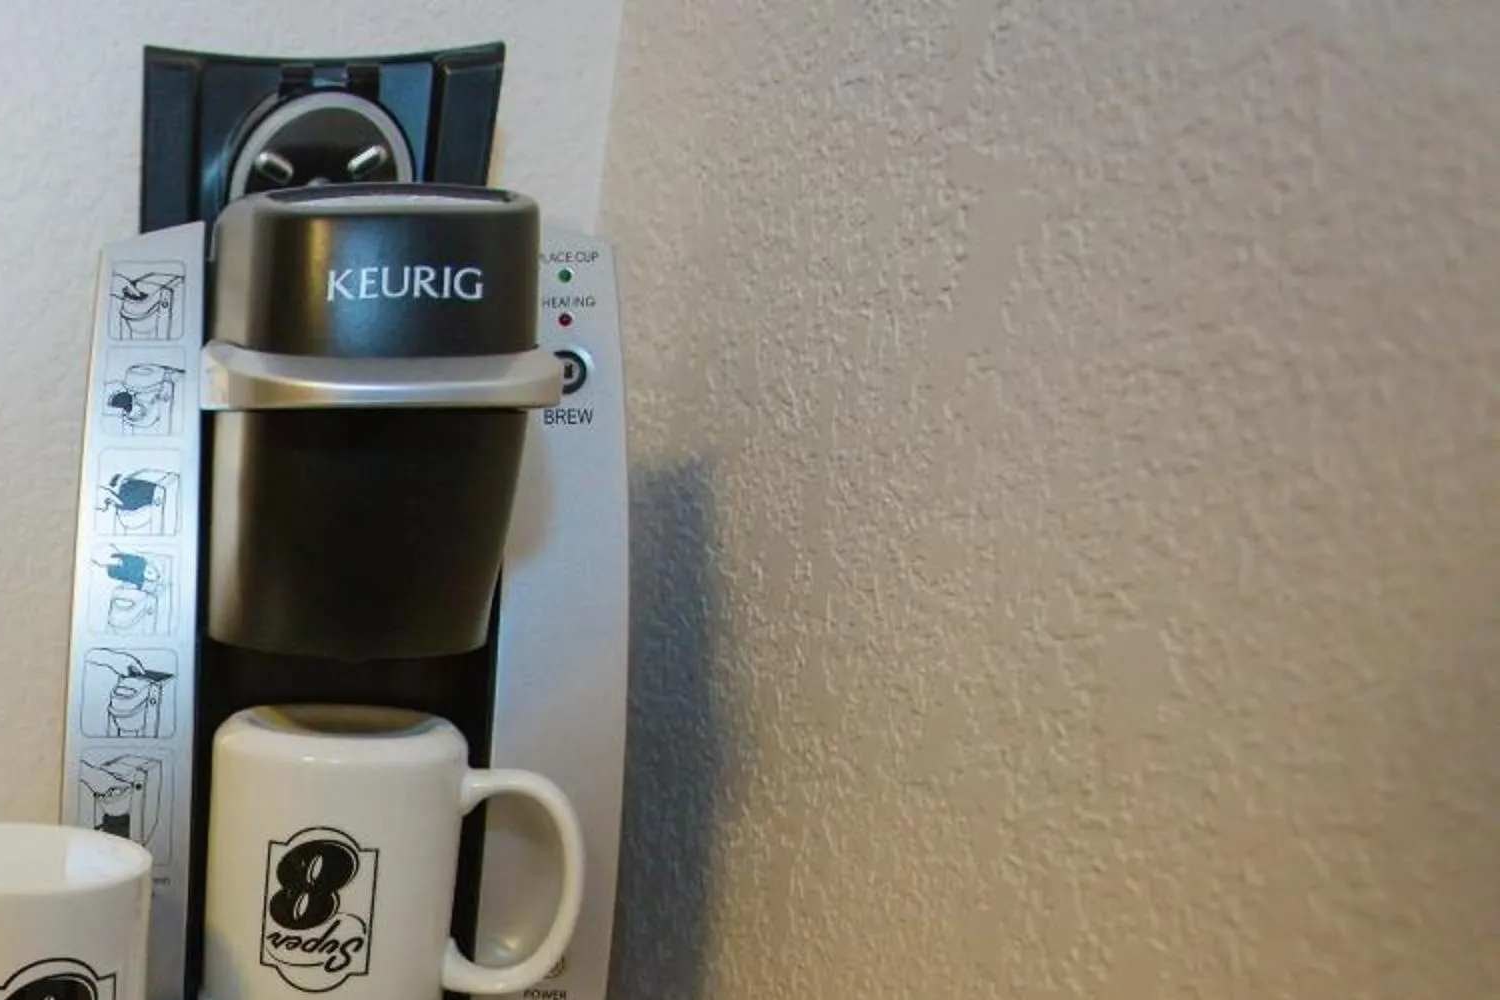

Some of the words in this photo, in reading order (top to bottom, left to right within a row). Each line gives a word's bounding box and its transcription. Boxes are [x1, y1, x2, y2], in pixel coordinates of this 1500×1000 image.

[539, 252, 572, 264] LACE
[327, 265, 484, 302] KEURIG
[542, 296, 597, 309] HEATING
[542, 408, 594, 425] BREW
[269, 839, 360, 930] 8
[266, 919, 364, 973] Super
[523, 988, 567, 1000] POWER
